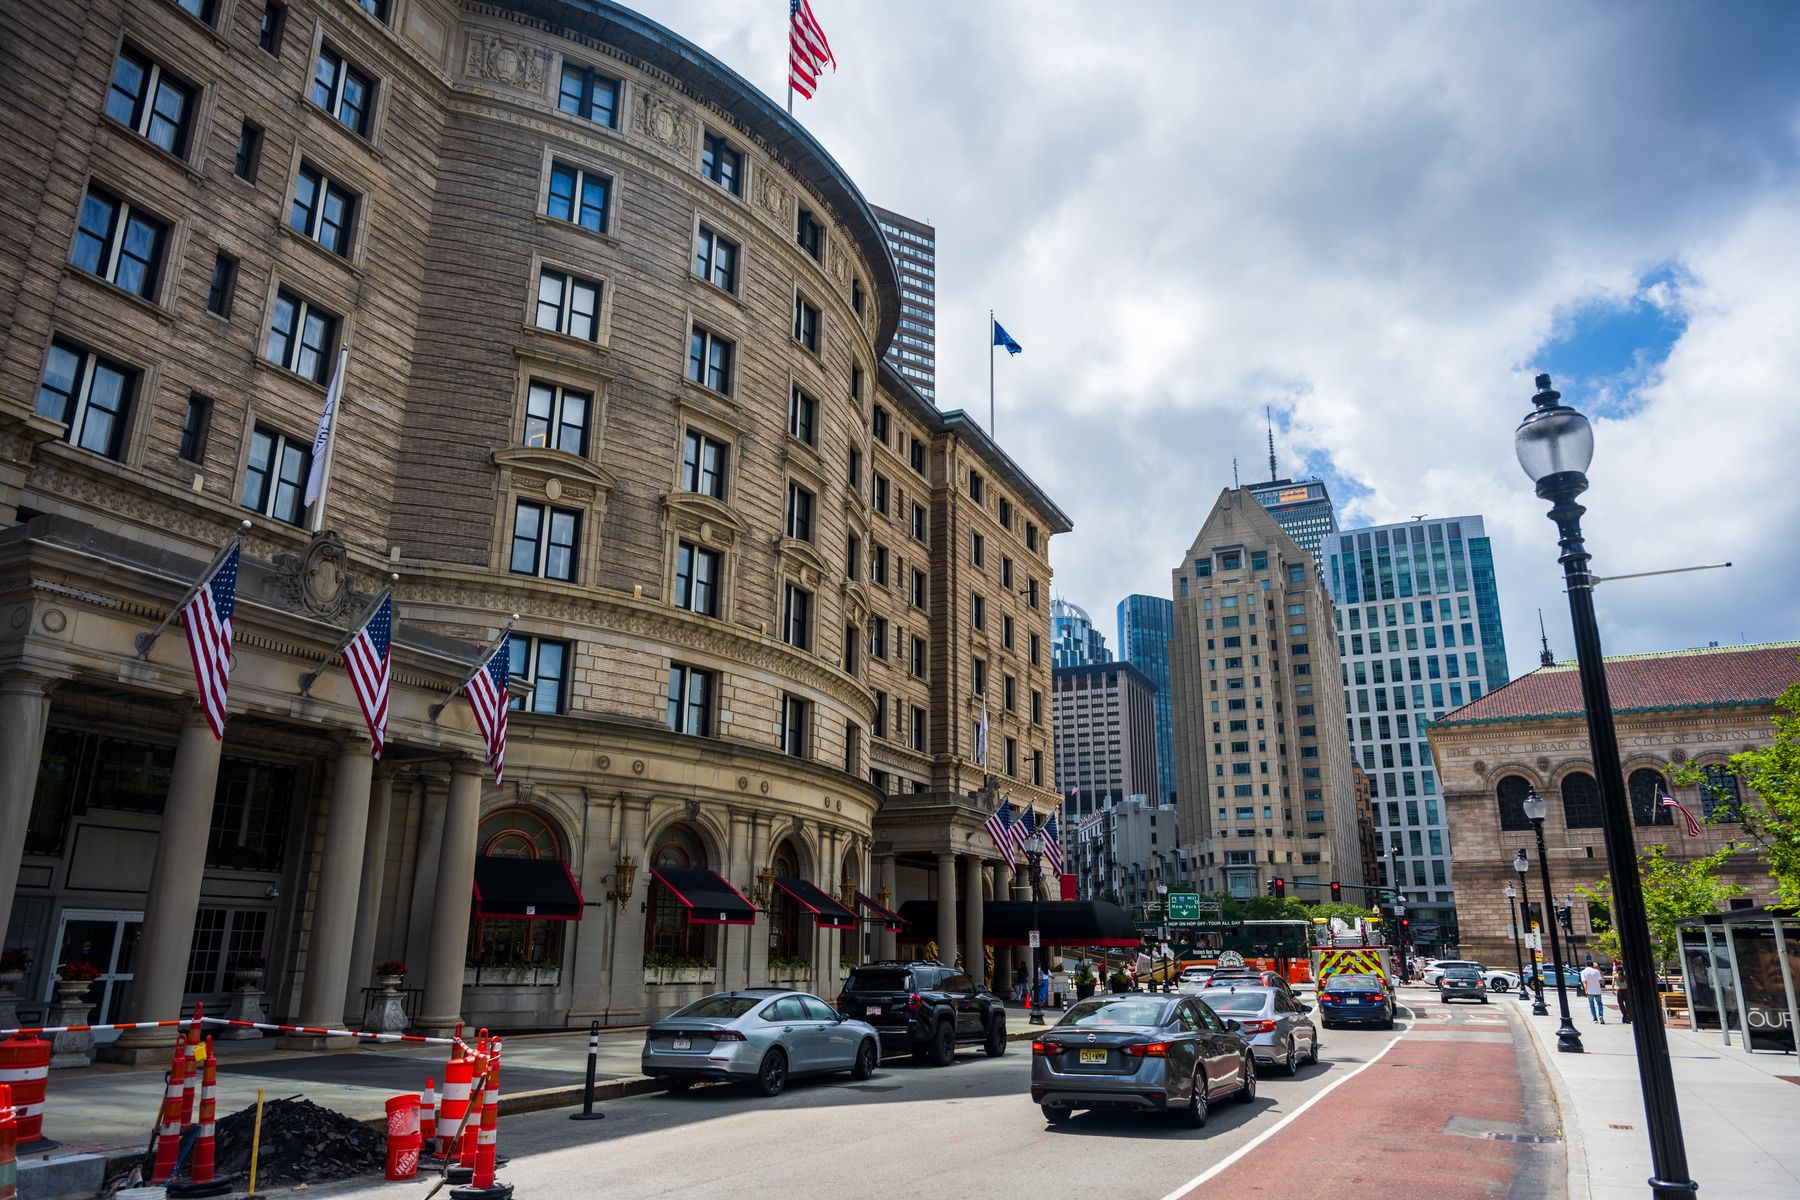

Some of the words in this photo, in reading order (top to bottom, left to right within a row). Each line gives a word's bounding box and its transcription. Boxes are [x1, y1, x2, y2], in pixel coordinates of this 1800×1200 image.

[1452, 747, 1472, 756] THE
[1479, 744, 1513, 755] PUBLIC
[1524, 741, 1571, 753] LIBRARY
[1633, 736, 1663, 746] CITY
[1672, 734, 1690, 744] OF
[1697, 730, 1750, 742] BOSTON
[395, 1149, 419, 1175] HOME
